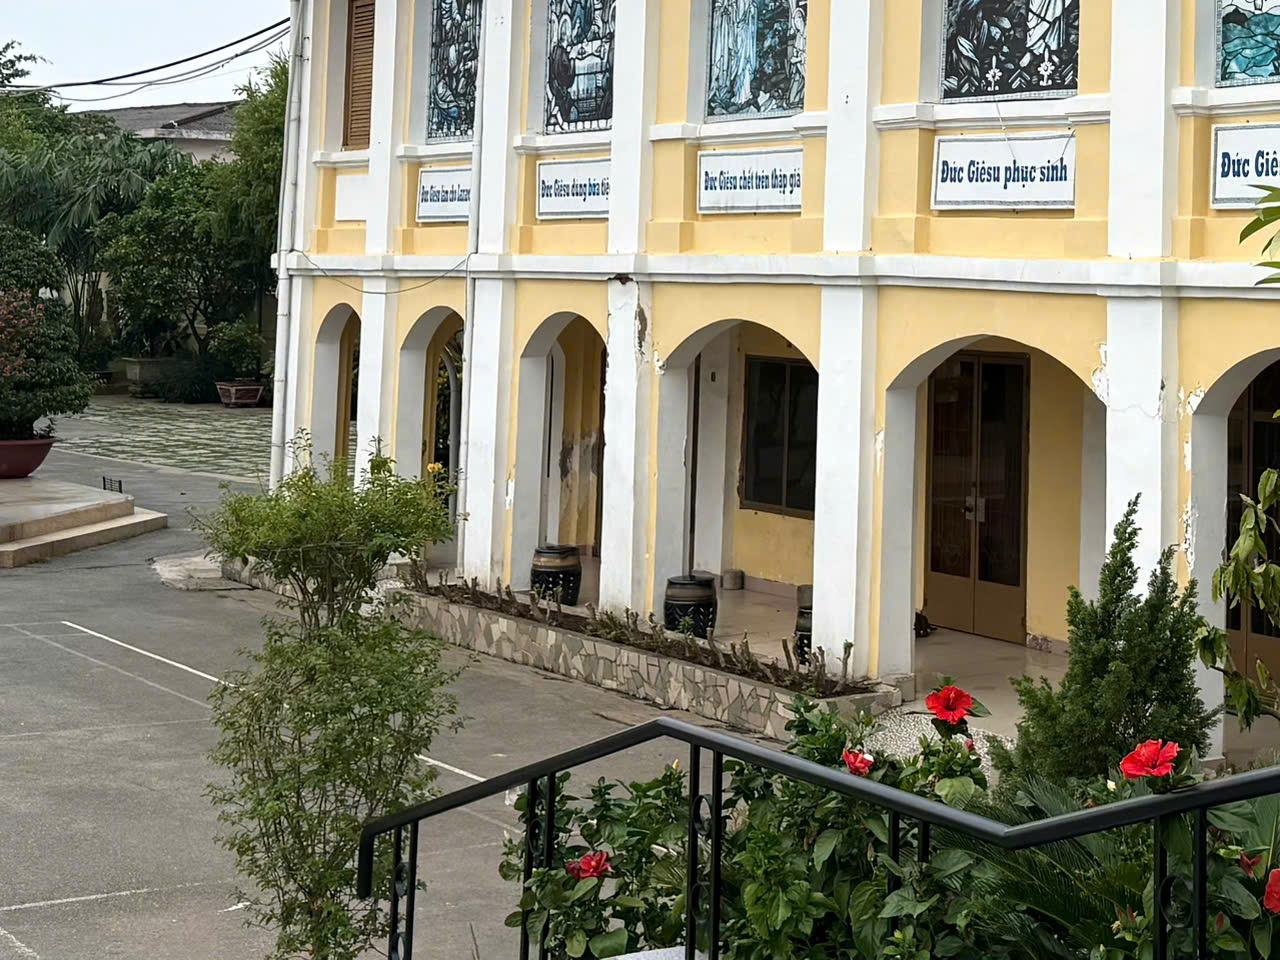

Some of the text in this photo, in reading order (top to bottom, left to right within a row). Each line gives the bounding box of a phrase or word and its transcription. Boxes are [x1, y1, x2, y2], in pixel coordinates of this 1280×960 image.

[940, 156, 1068, 190] Đức Giêsu phục sinh
[1221, 151, 1250, 178] Đức
[704, 170, 717, 191] Đức
[719, 169, 738, 190] Giêsu
[739, 167, 754, 190] chết
[755, 169, 770, 190] trên
[771, 167, 788, 195] thập
